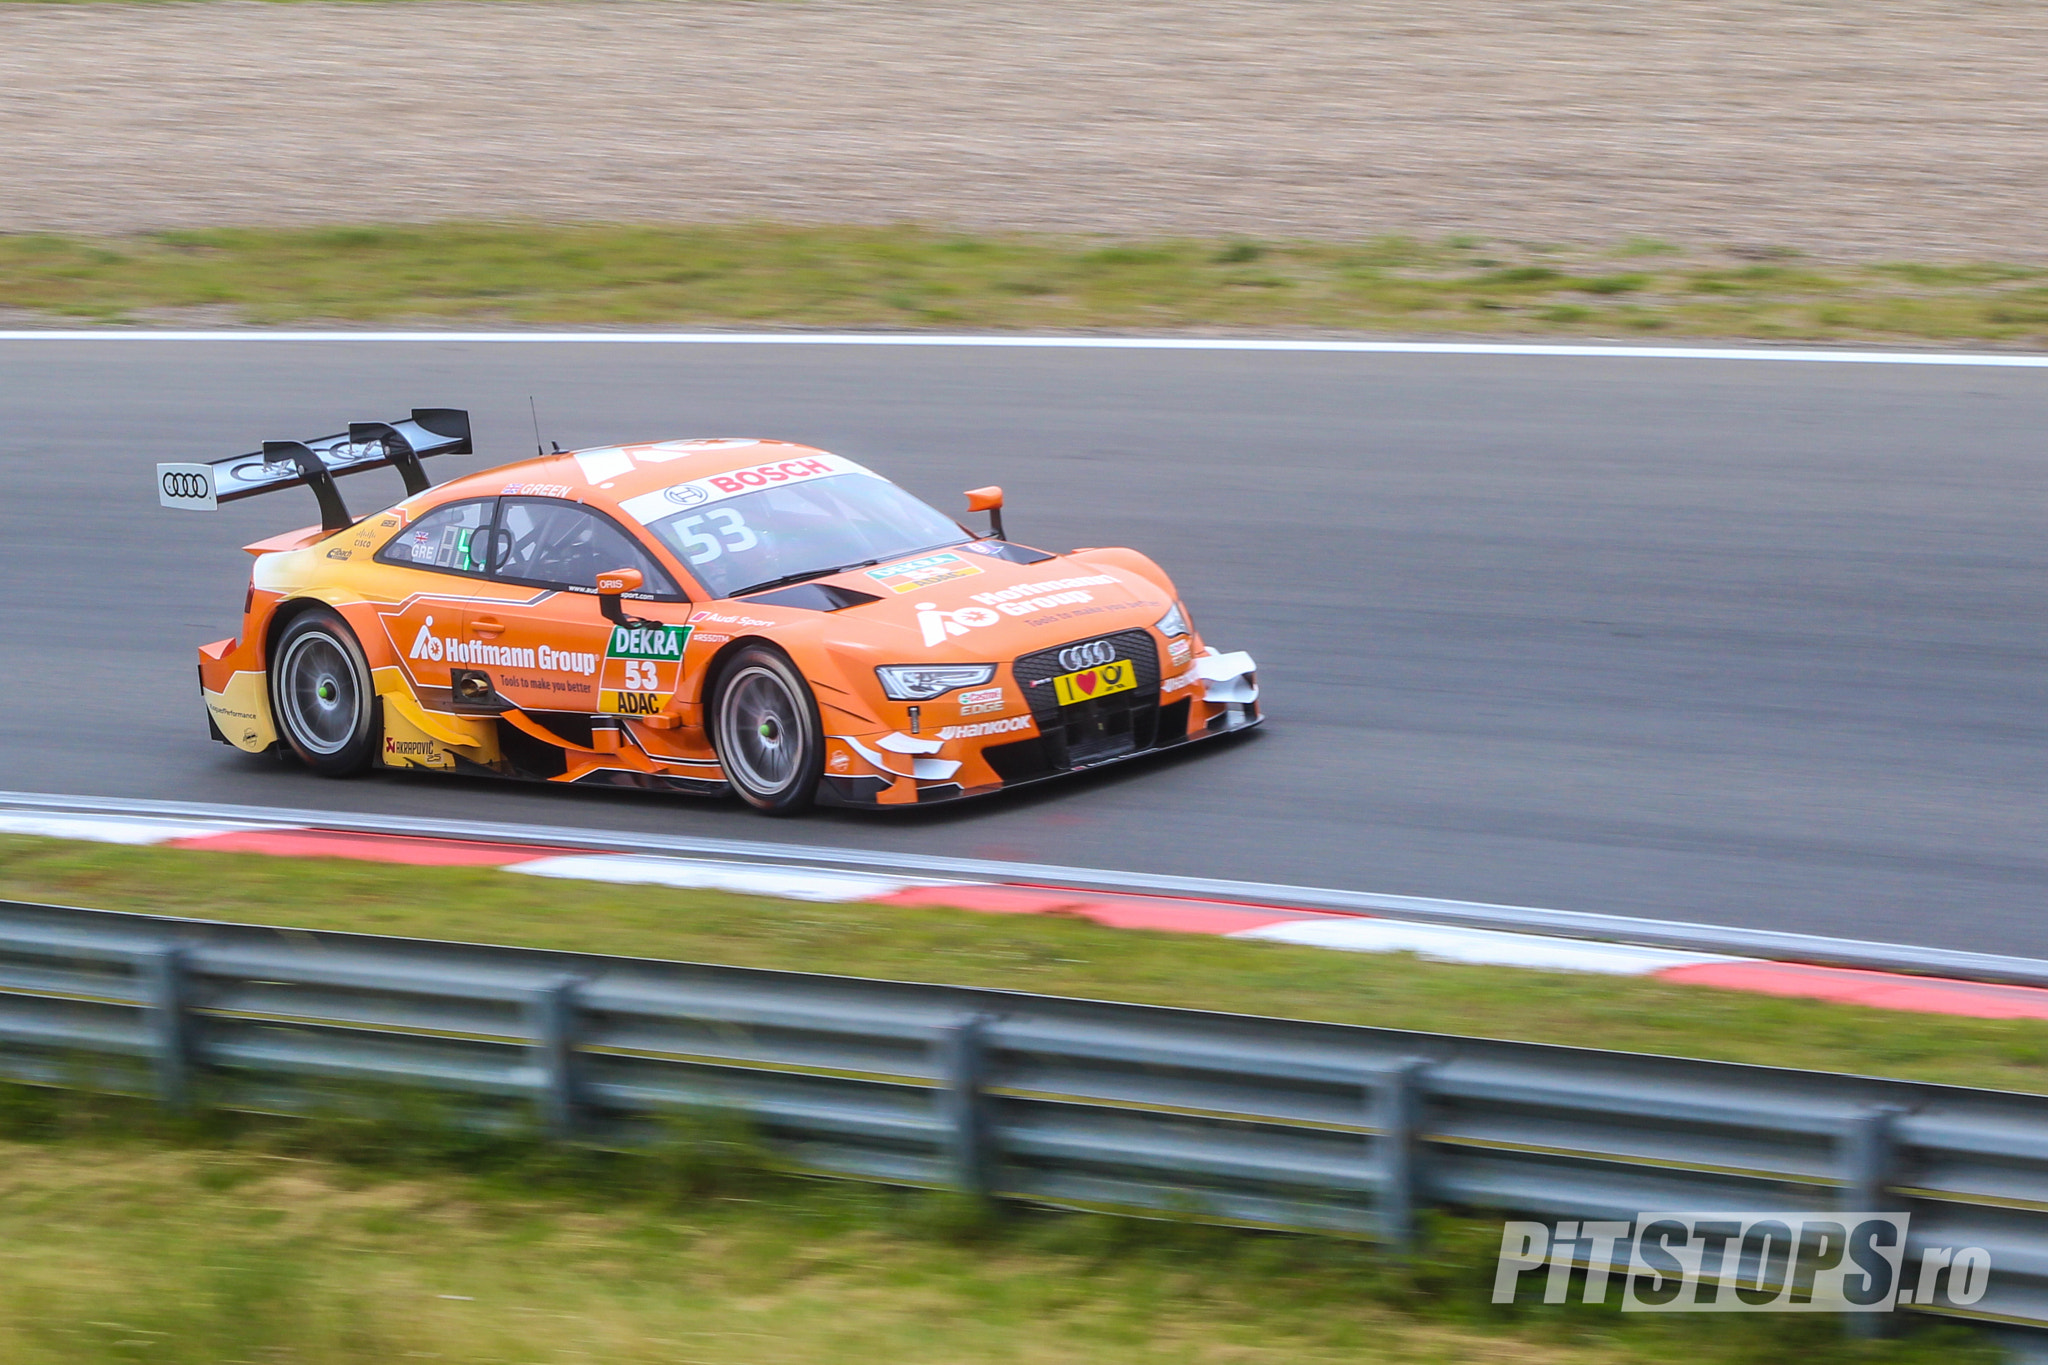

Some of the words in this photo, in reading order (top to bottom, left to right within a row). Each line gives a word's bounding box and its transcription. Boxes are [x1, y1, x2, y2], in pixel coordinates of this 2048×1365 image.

[709, 459, 834, 494] BOSCH
[520, 484, 573, 498] GREEN
[670, 506, 758, 565] 53
[411, 544, 434, 559] GRE
[871, 556, 950, 577] DEKRA
[599, 579, 623, 589] ORIS
[912, 571, 967, 586] ADAC
[970, 574, 1123, 606] Hoffmann
[995, 591, 1094, 617] Group
[706, 613, 739, 623] Audi
[737, 616, 775, 627] Sport
[1025, 615, 1057, 628] Tools
[1059, 612, 1073, 620] to
[615, 628, 680, 656] DEKRA
[445, 637, 535, 669] Hoffmann
[500, 674, 519, 688] Tools
[520, 678, 529, 688] to
[530, 677, 551, 690] make
[552, 681, 566, 693] you
[567, 680, 591, 694] better
[625, 661, 659, 690] 53
[618, 692, 660, 714] ADAC
[960, 701, 1005, 716] EDGE
